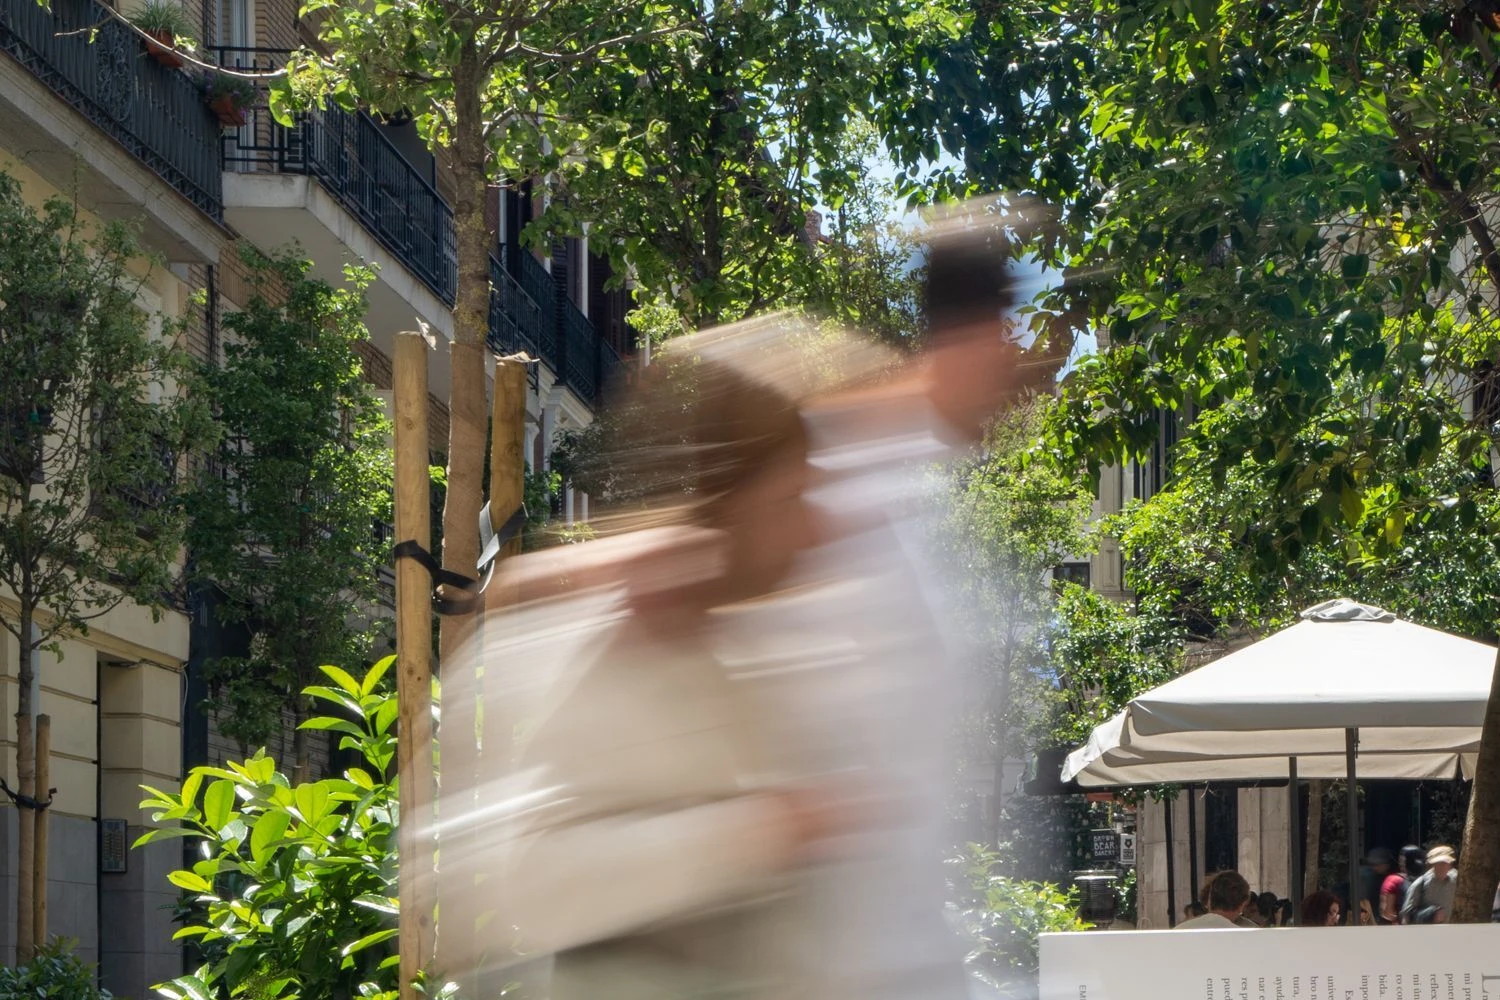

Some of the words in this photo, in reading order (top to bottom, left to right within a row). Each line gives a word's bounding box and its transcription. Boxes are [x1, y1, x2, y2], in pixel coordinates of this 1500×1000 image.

[1095, 842, 1115, 850] BEAR
[1396, 974, 1402, 985] ro
[1413, 974, 1421, 986] mi
[1464, 973, 1472, 985] mi
[1379, 974, 1388, 997] bida.
[1444, 973, 1454, 1000] poner
